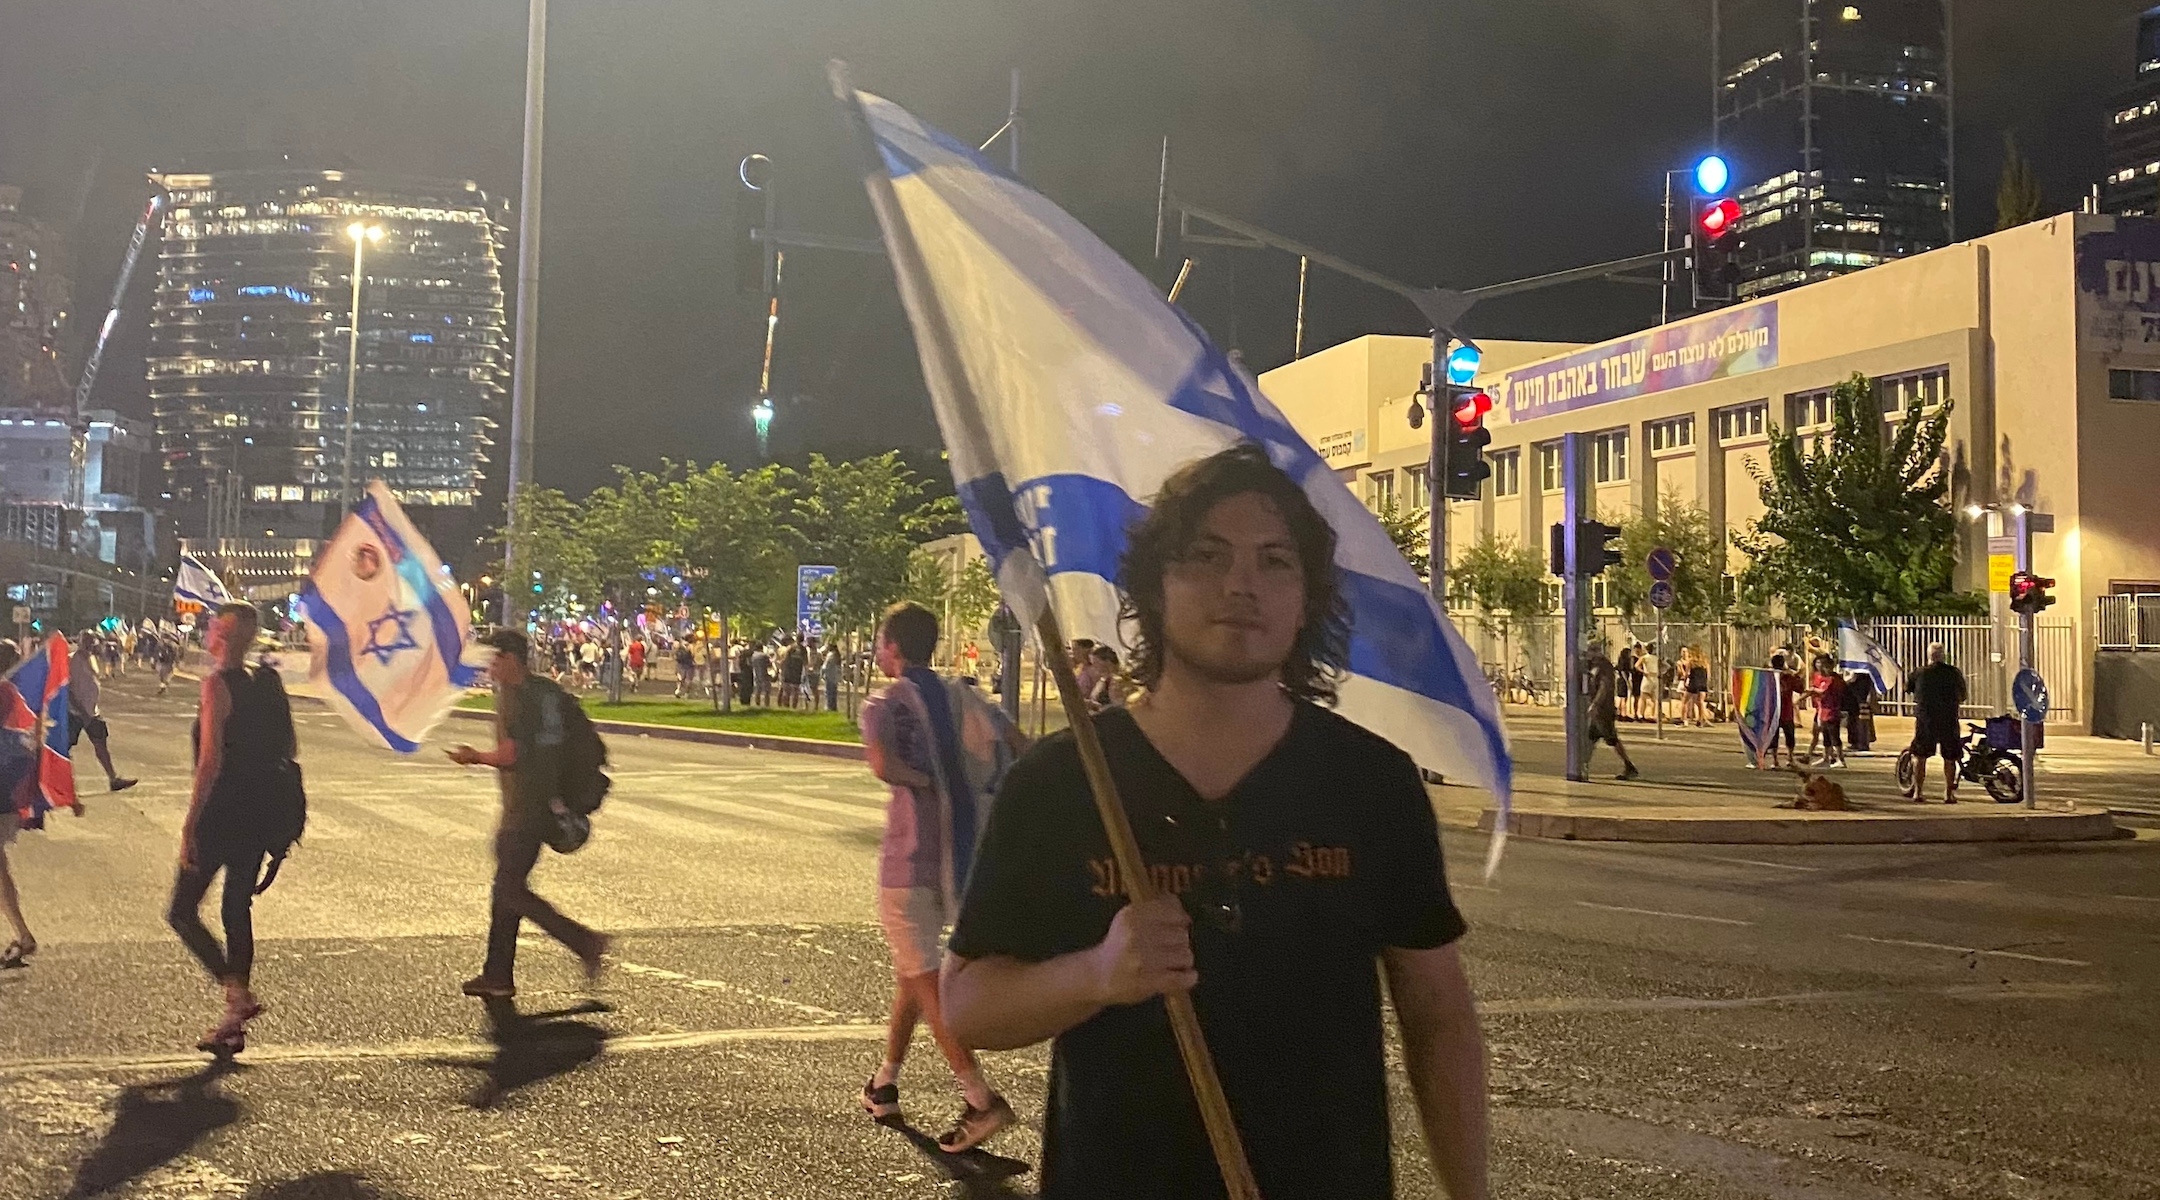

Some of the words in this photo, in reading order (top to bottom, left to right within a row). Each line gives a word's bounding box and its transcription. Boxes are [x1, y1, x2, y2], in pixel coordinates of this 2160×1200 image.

[1678, 343, 1705, 365] נוצח
[1708, 335, 1725, 359] לא
[1728, 326, 1769, 354] מעולם
[1601, 348, 1646, 391] שבחר
[1652, 350, 1677, 371] העם
[1514, 375, 1545, 411] חינם
[1547, 361, 1598, 403] באהבת
